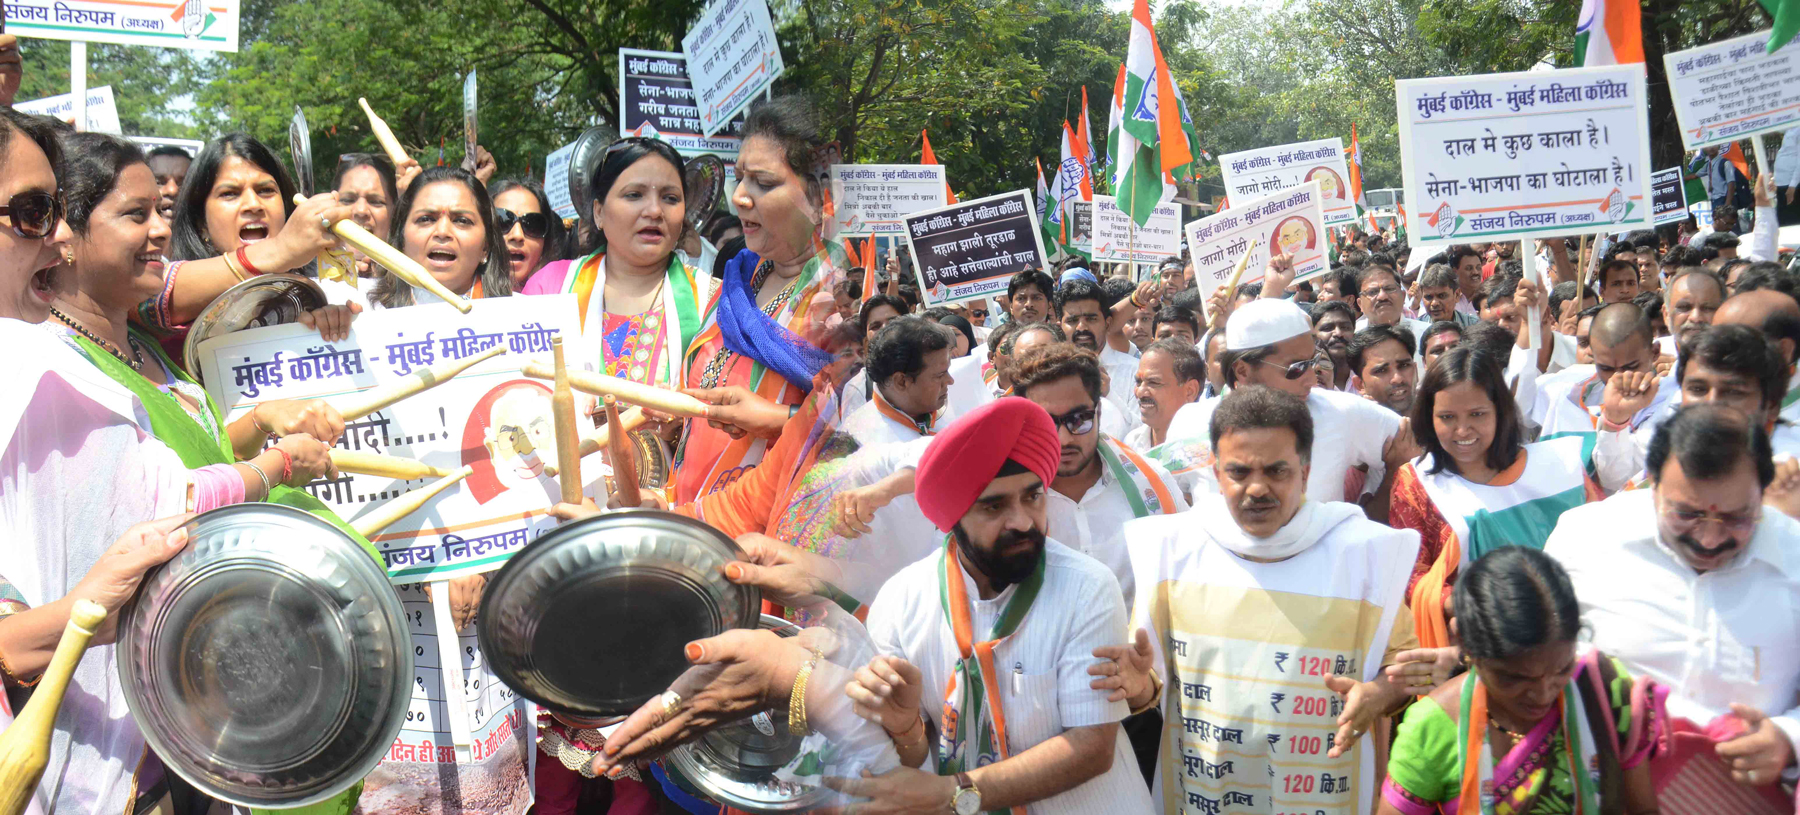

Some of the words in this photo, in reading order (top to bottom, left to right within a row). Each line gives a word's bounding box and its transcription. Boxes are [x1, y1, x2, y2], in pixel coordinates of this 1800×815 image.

[54, 2, 115, 26] निरुपम
[121, 16, 164, 31] (अध्यक्ष)
[1416, 91, 1447, 118] मुंबई
[1506, 84, 1536, 112] मुंबई
[1539, 83, 1582, 104] महिला
[1443, 137, 1476, 159] दाल
[1481, 128, 1497, 153] मे
[1502, 134, 1533, 159] कुछ
[1538, 129, 1582, 149] काला
[1236, 179, 1259, 196] जागो
[1426, 172, 1521, 199] सेना-भाजपा
[1525, 172, 1547, 190] का
[1552, 162, 1608, 188] घोटाला
[975, 206, 999, 220] महिला
[1470, 214, 1506, 231] संजय
[1508, 211, 1556, 228] निरुपम
[1561, 211, 1594, 225] (अध्यक्ष)
[959, 232, 983, 250] झाली
[984, 229, 1016, 250] तूरडाळ
[1200, 244, 1225, 266] जागो
[926, 265, 937, 282] ही
[940, 261, 959, 279] आहे
[1014, 250, 1034, 263] चाल
[974, 280, 999, 294] निरुपम
[232, 352, 284, 398] मुंबई
[385, 331, 435, 377] मुंबई
[442, 527, 528, 562] निरुपम
[1299, 656, 1331, 677] 120
[1293, 696, 1327, 716] 200
[1289, 736, 1321, 754] 100
[1284, 775, 1314, 793] 120
